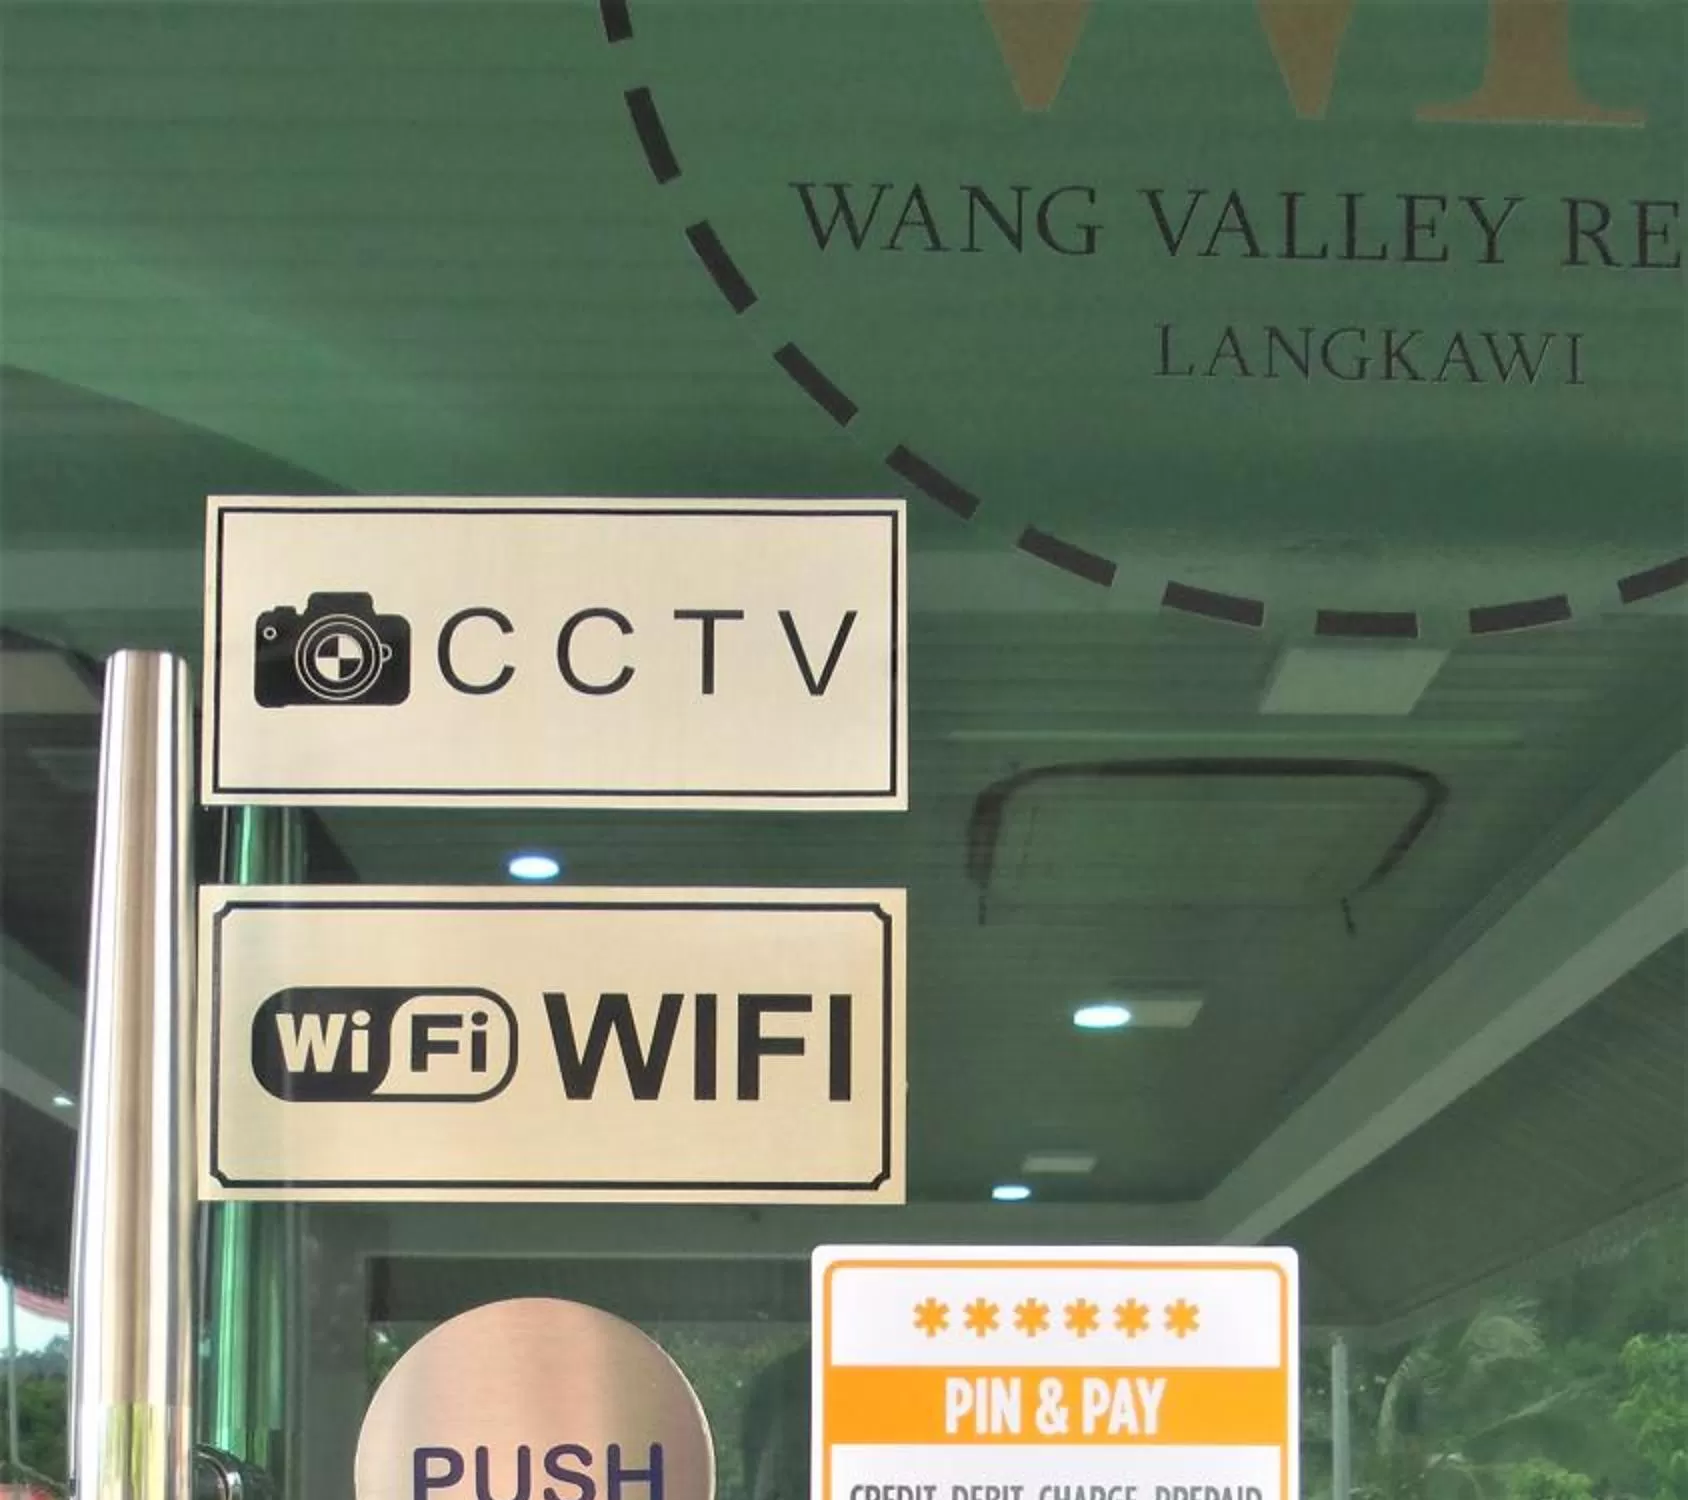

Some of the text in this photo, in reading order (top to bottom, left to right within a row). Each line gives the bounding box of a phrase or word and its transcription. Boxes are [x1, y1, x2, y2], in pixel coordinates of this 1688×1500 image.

[790, 182, 1681, 269] WANG VALLEY RE
[1154, 323, 1587, 386] LANGKAWI
[437, 606, 858, 697] CCTV
[542, 992, 853, 1102] WIFI
[944, 1376, 1167, 1435] PIN & PAY
